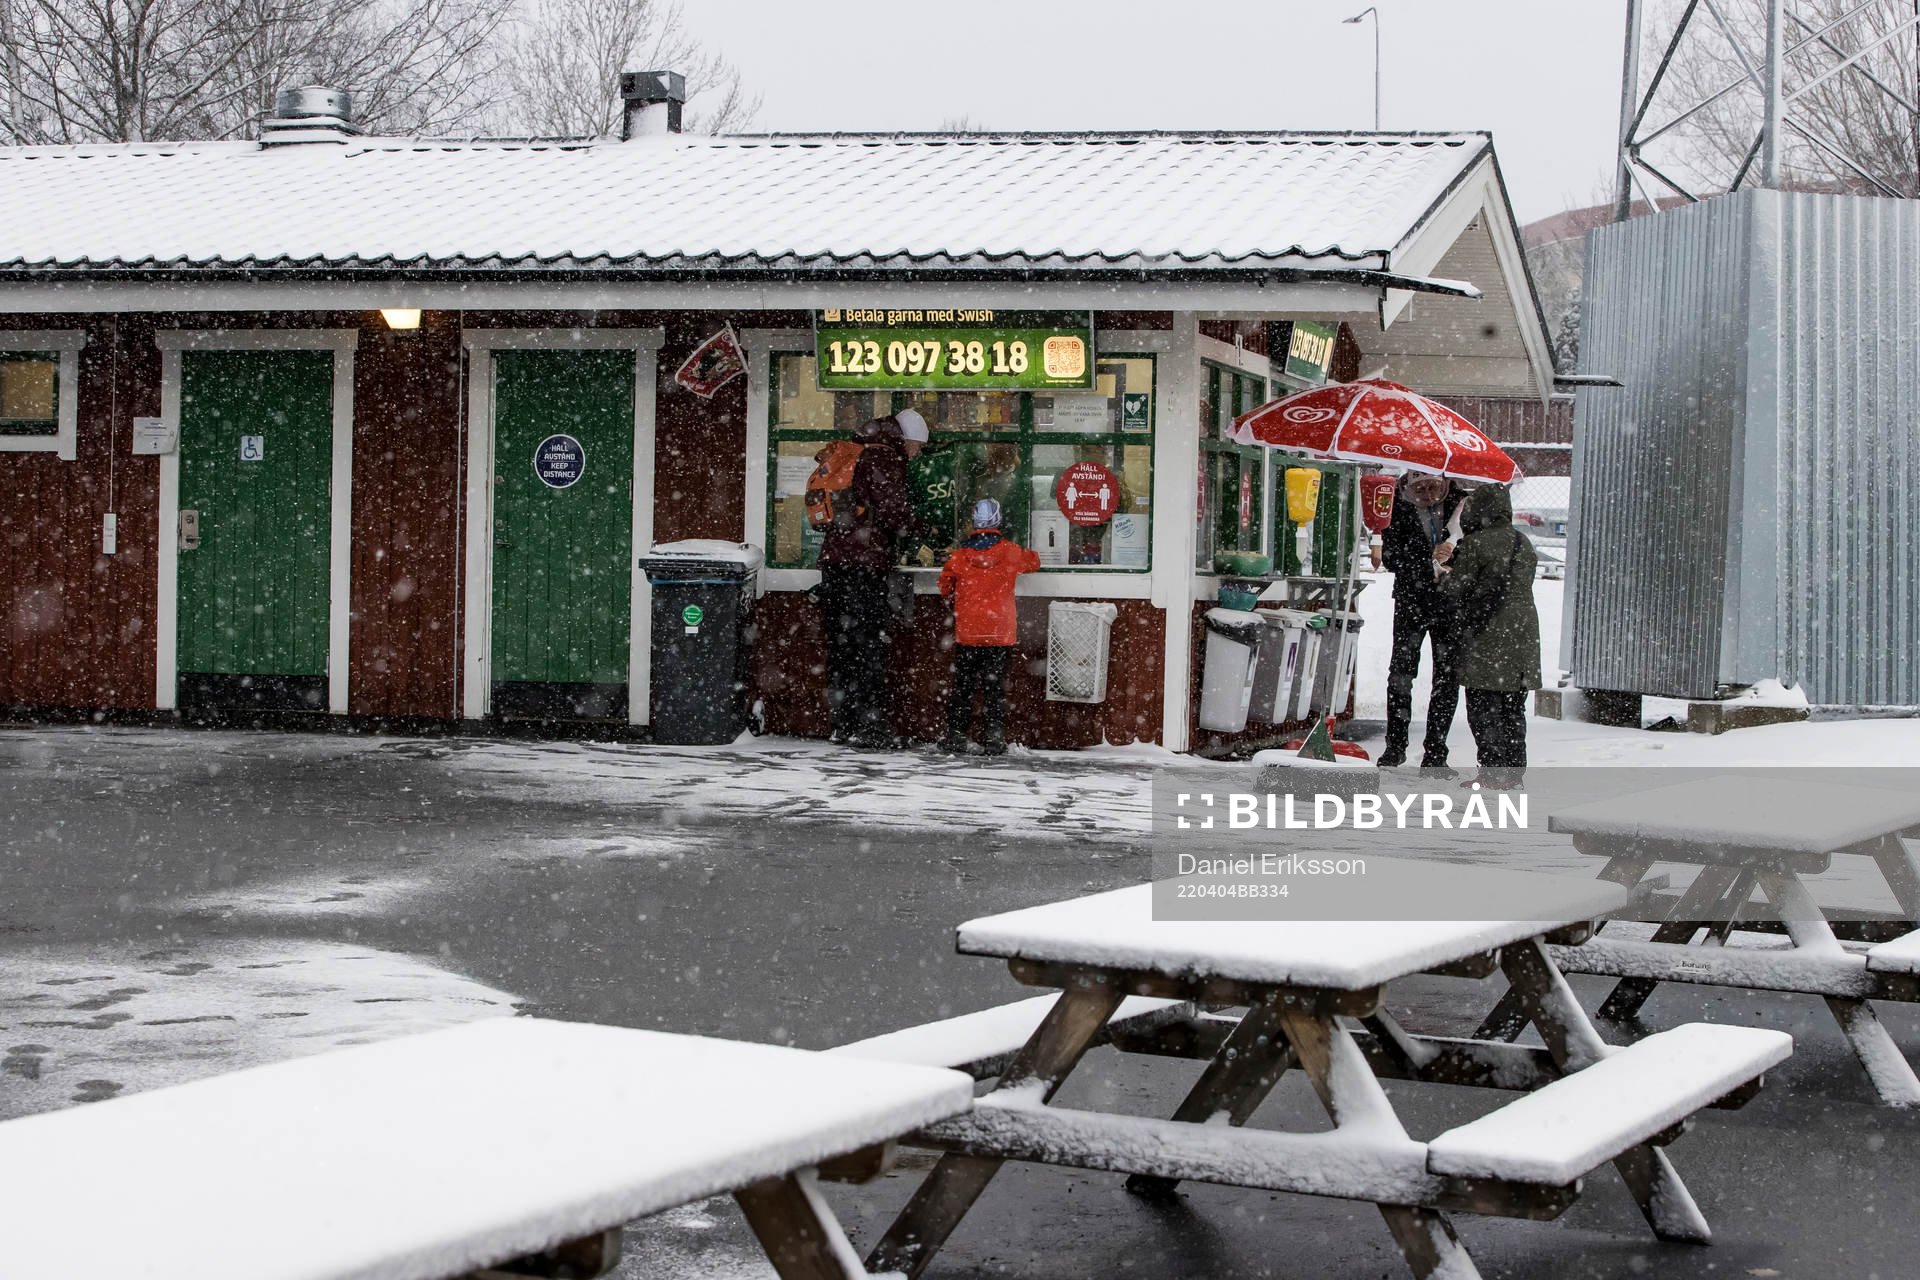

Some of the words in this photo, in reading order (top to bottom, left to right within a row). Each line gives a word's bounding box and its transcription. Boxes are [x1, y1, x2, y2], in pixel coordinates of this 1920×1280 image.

[846, 308, 884, 322] Betala
[926, 308, 954, 322] med
[957, 308, 993, 322] Swish
[829, 340, 881, 373] 123
[887, 340, 942, 373] 097
[948, 340, 985, 373] 38
[992, 340, 1029, 373] 18
[550, 462, 569, 470] KEEP
[1080, 463, 1098, 472] HÅLL
[543, 470, 576, 478] DISTANCE
[1071, 472, 1106, 481] AVSTÅND!
